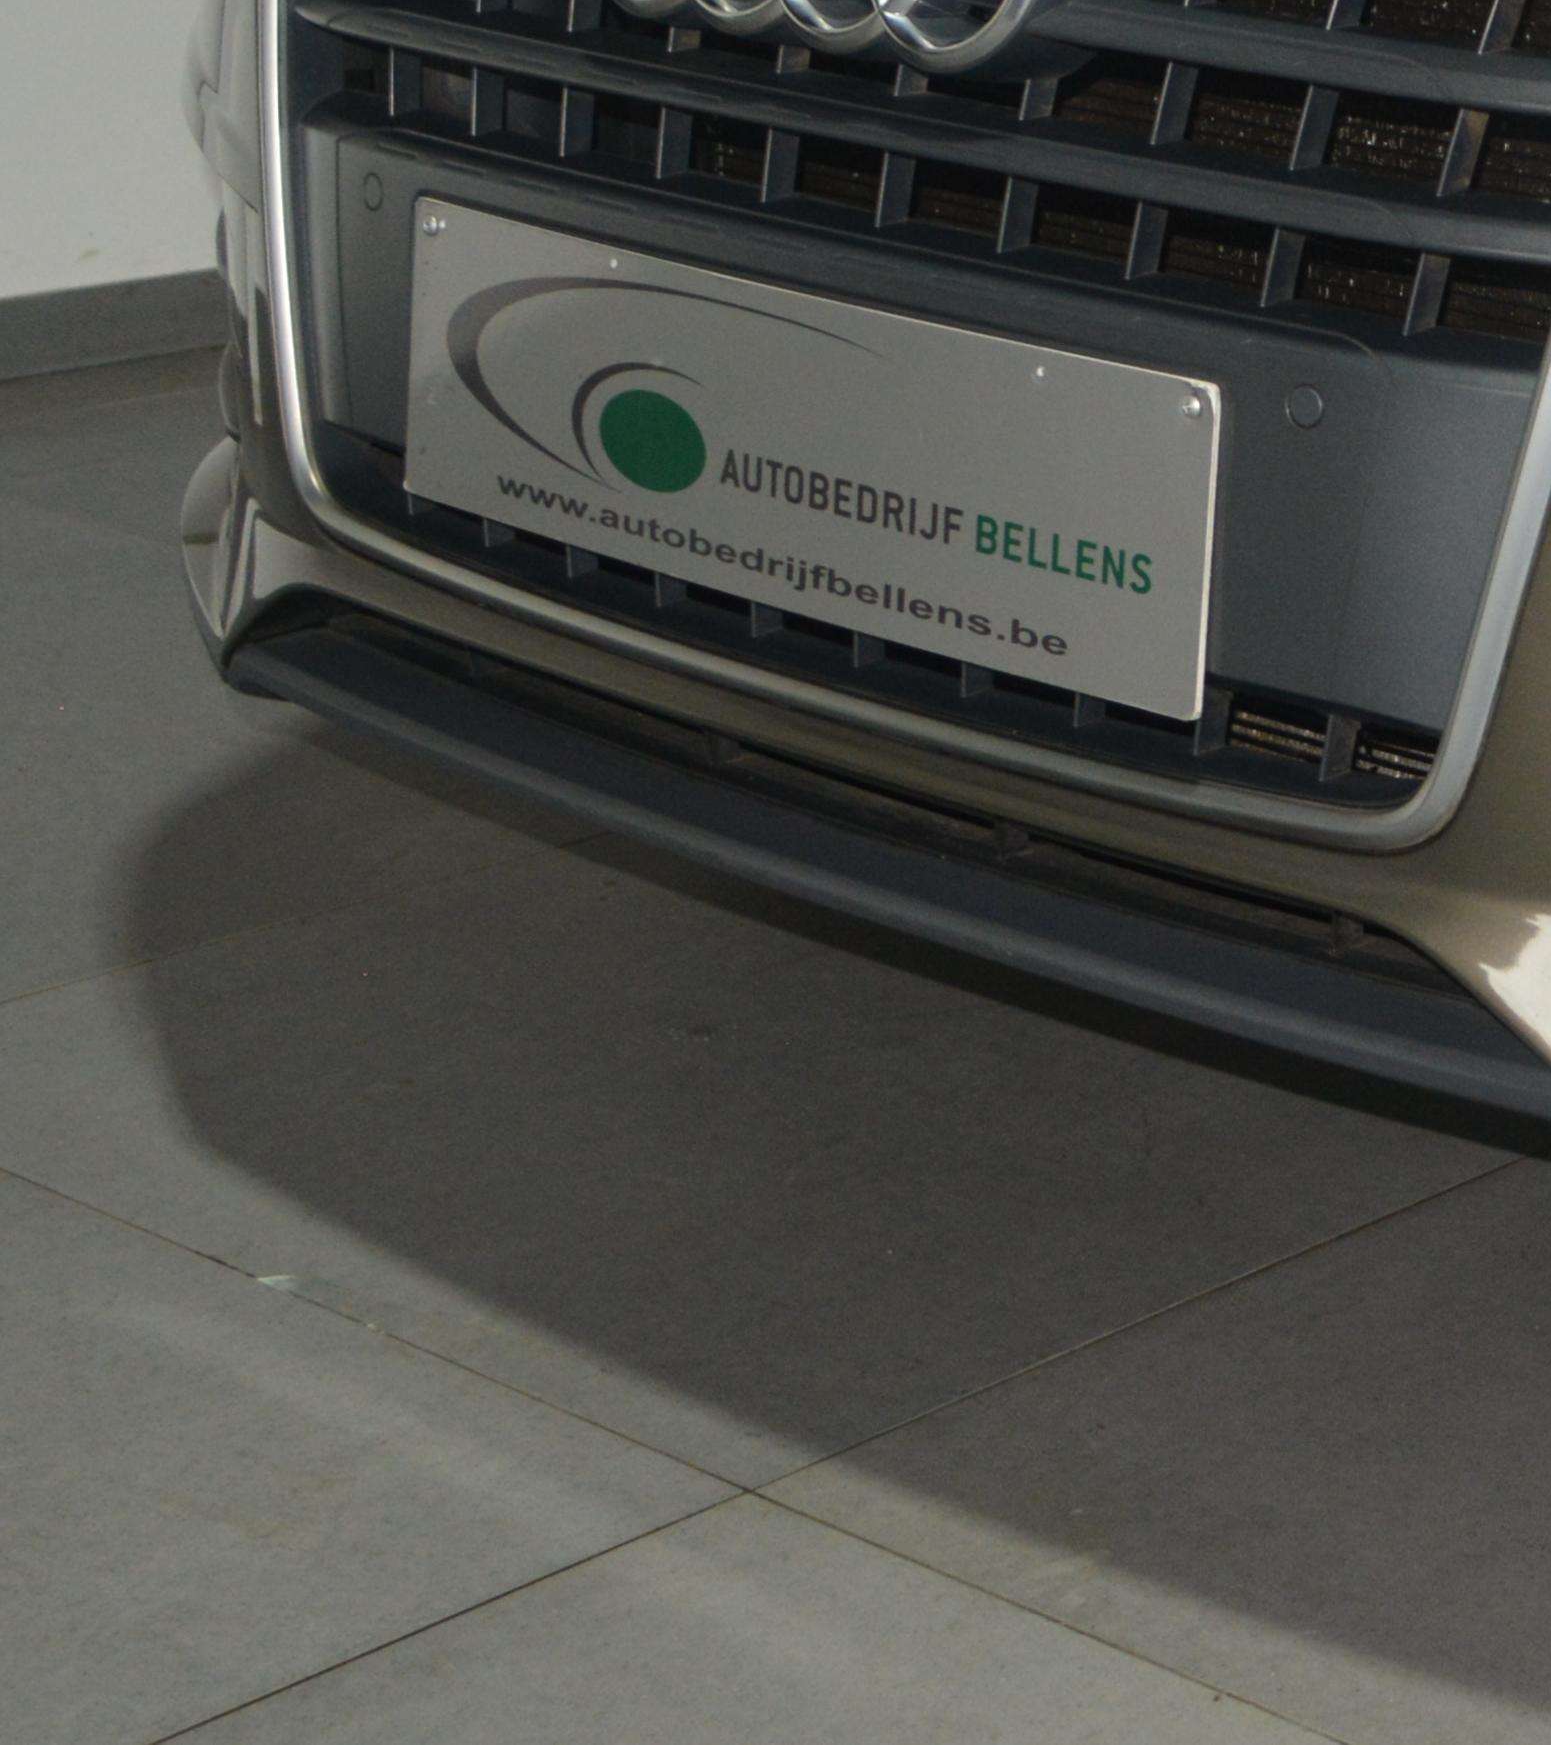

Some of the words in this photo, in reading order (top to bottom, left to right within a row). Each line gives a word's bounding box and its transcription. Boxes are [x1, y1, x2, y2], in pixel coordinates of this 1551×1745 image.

[497, 475, 1069, 656] www.autobedrijfbellens.be
[719, 449, 965, 546] AUTOBEDRIJF
[975, 516, 1154, 594] BELLENS
